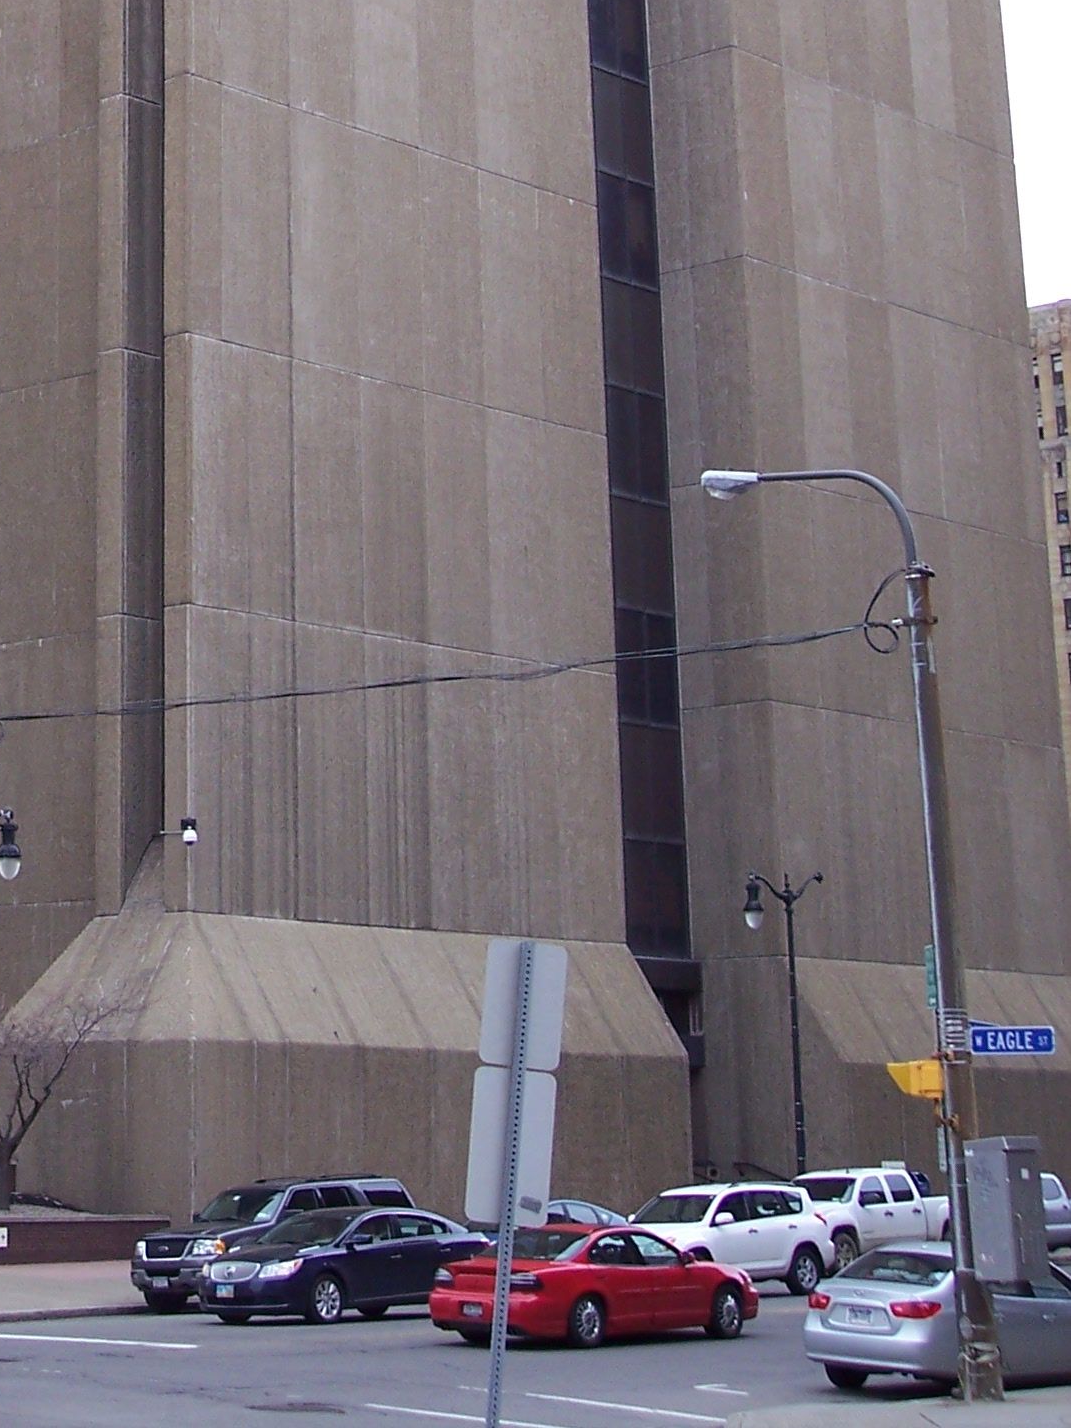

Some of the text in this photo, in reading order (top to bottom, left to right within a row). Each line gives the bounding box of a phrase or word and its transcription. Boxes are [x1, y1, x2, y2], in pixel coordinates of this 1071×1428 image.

[974, 1031, 1049, 1050] W EAGLE ST
